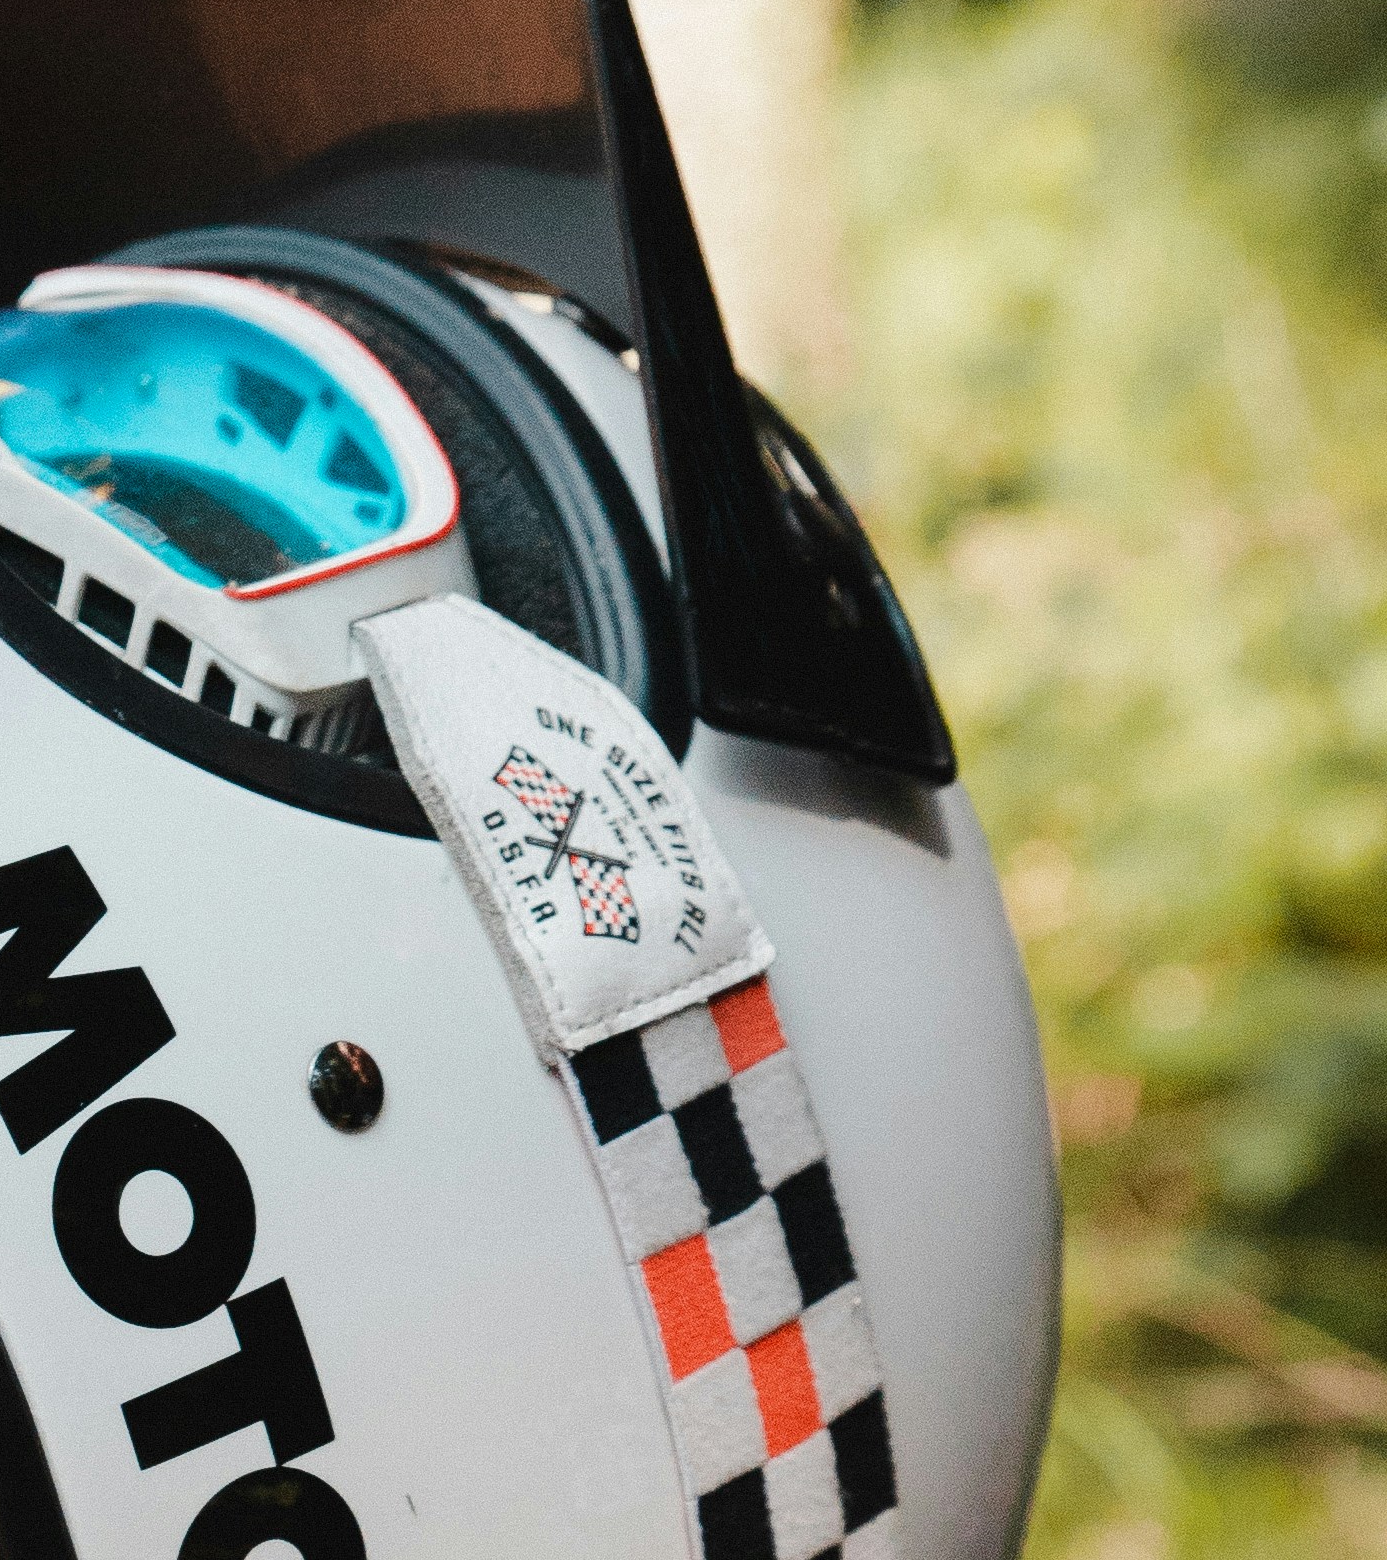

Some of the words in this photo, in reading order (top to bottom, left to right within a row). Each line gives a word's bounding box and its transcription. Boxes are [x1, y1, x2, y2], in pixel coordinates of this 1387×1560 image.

[536, 706, 595, 748] ONE
[607, 745, 668, 810] SIZE
[661, 824, 706, 892] FITS
[674, 899, 707, 955] ALL
